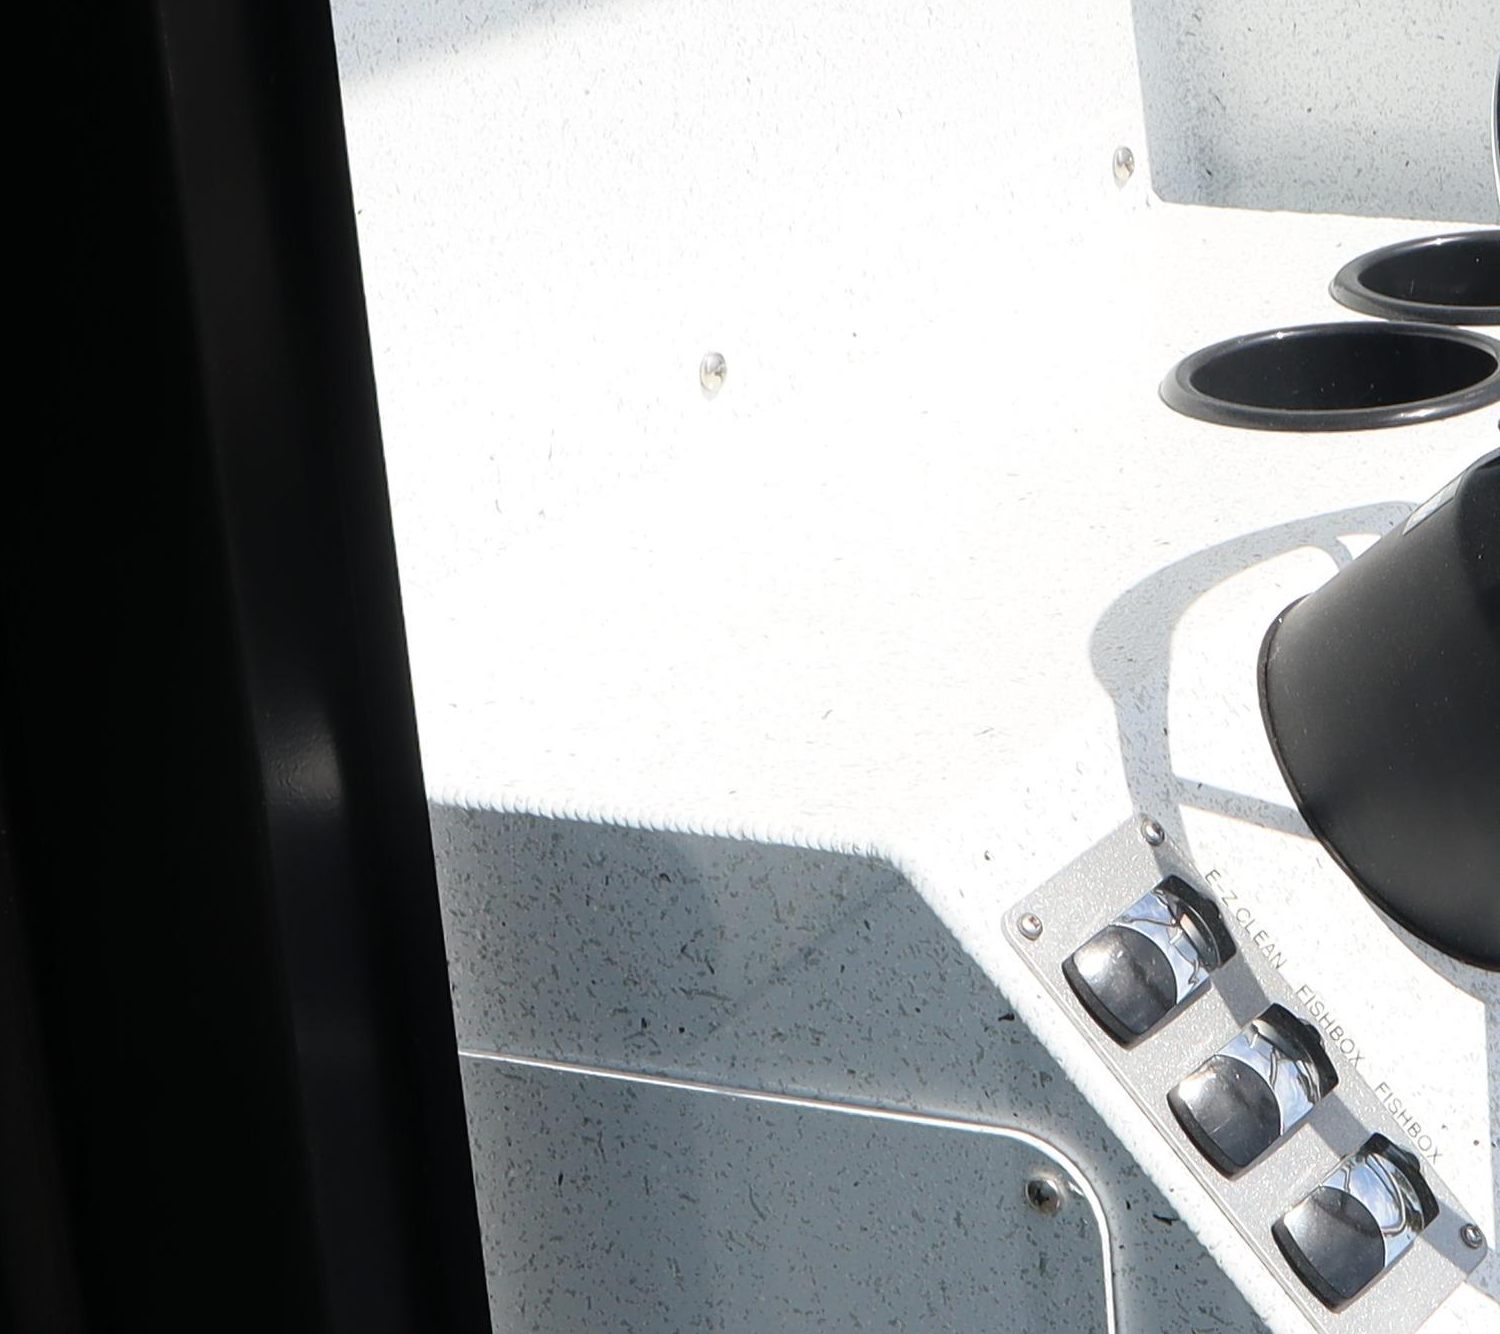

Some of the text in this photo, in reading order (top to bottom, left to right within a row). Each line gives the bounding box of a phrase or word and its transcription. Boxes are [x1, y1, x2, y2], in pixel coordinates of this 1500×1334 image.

[1235, 908, 1287, 970] CLEAN
[1295, 984, 1366, 1065] FISHBOX
[1374, 1081, 1443, 1165] FISHBOX
